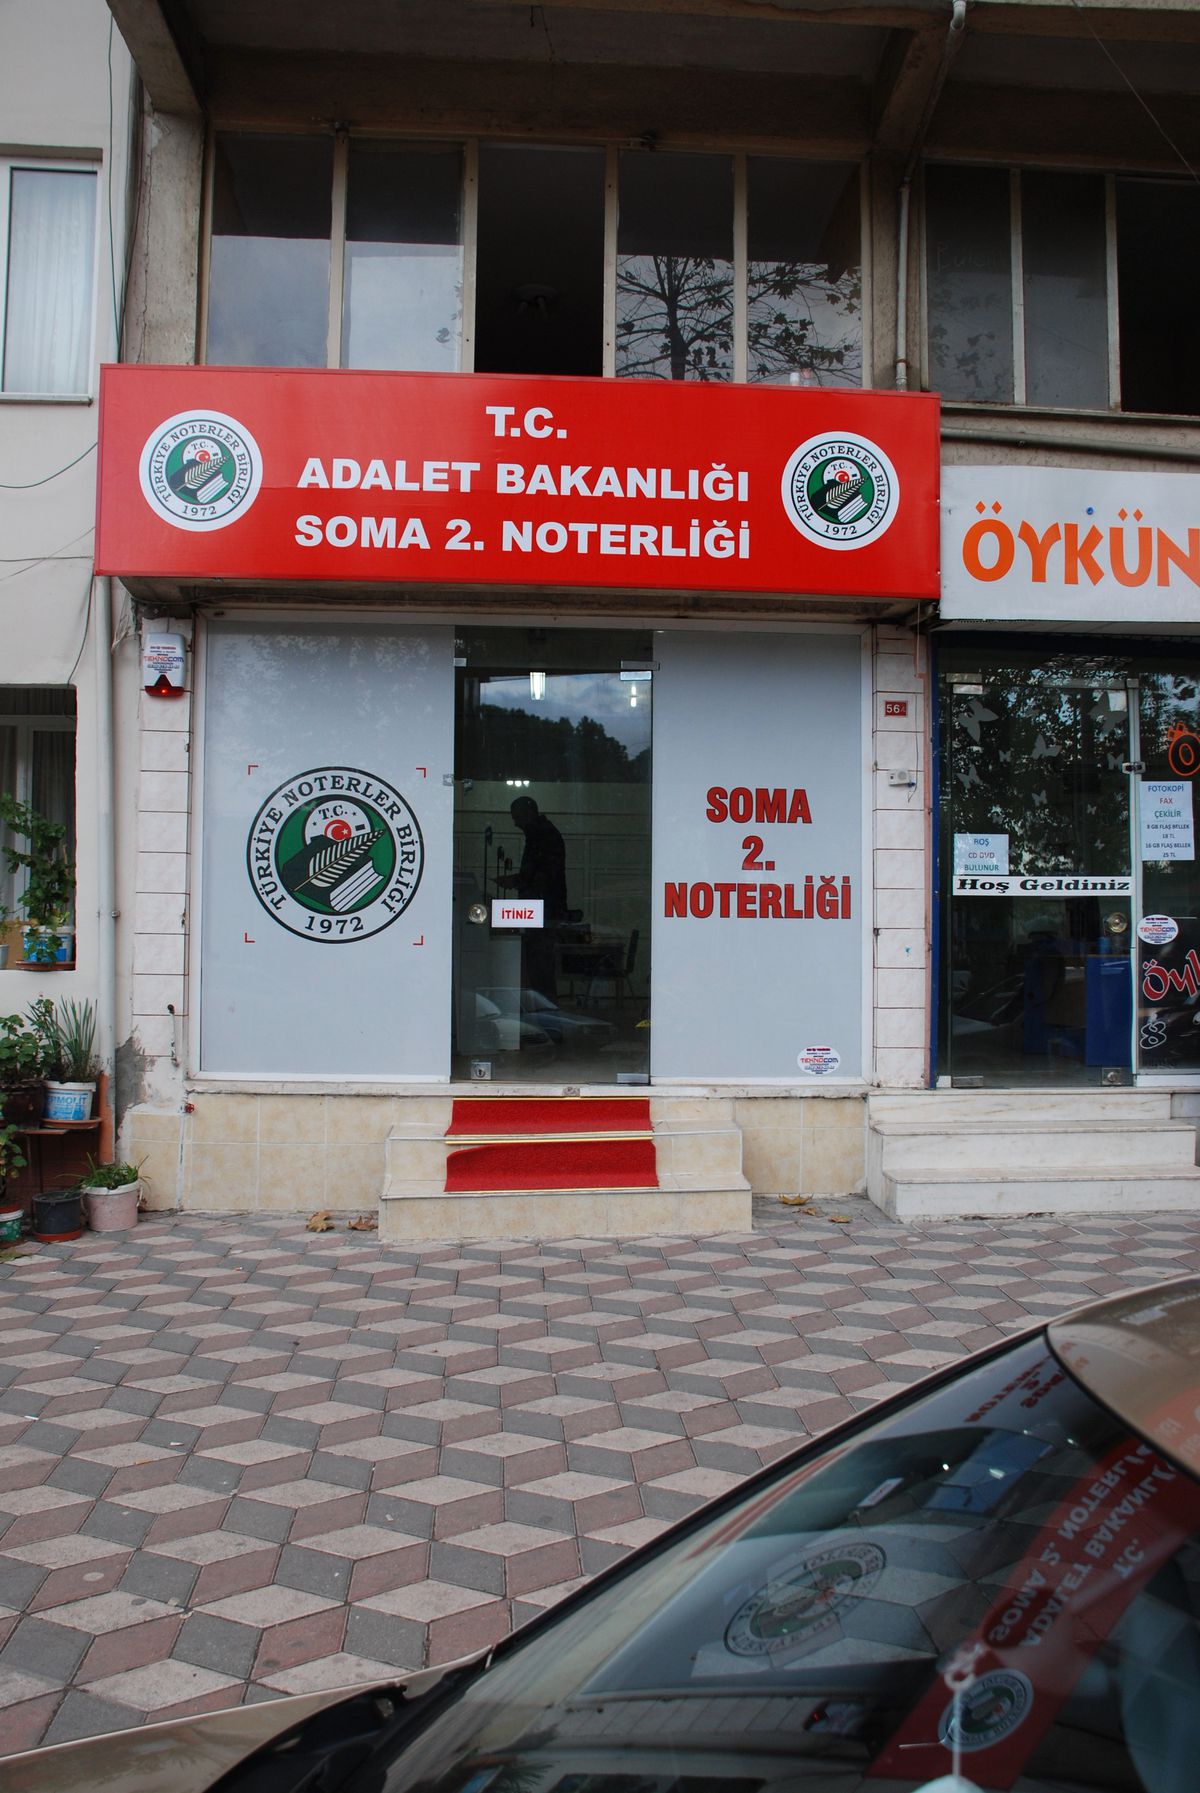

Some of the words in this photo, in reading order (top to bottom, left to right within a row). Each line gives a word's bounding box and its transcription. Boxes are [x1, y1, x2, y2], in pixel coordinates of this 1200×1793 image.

[486, 406, 567, 439] T.C.
[170, 424, 240, 450] NOTERLER
[811, 445, 877, 472] NOTERLER
[297, 457, 480, 493] ADALET
[496, 462, 749, 502] BAKANLIĞI
[182, 505, 217, 516] 1972
[295, 514, 431, 550] SOMA
[444, 519, 485, 551] 2.
[502, 519, 750, 559] NOTERLİĞİ
[824, 524, 857, 535] 1972
[1148, 784, 1184, 792] FOTOKOPİ
[318, 805, 348, 820] T.C.
[706, 786, 813, 824] SOMA
[253, 807, 287, 911] TÜRKİYE
[282, 775, 401, 820] NOTERLER
[381, 823, 418, 914] BİRLİĞİ
[741, 835, 775, 871] 2.
[664, 875, 851, 919] NOTERLİĞİ
[956, 878, 1010, 894] Hoş
[1019, 878, 1130, 891] Geldiniz
[305, 916, 364, 934] 1972
[502, 907, 535, 920] İTİNİZ
